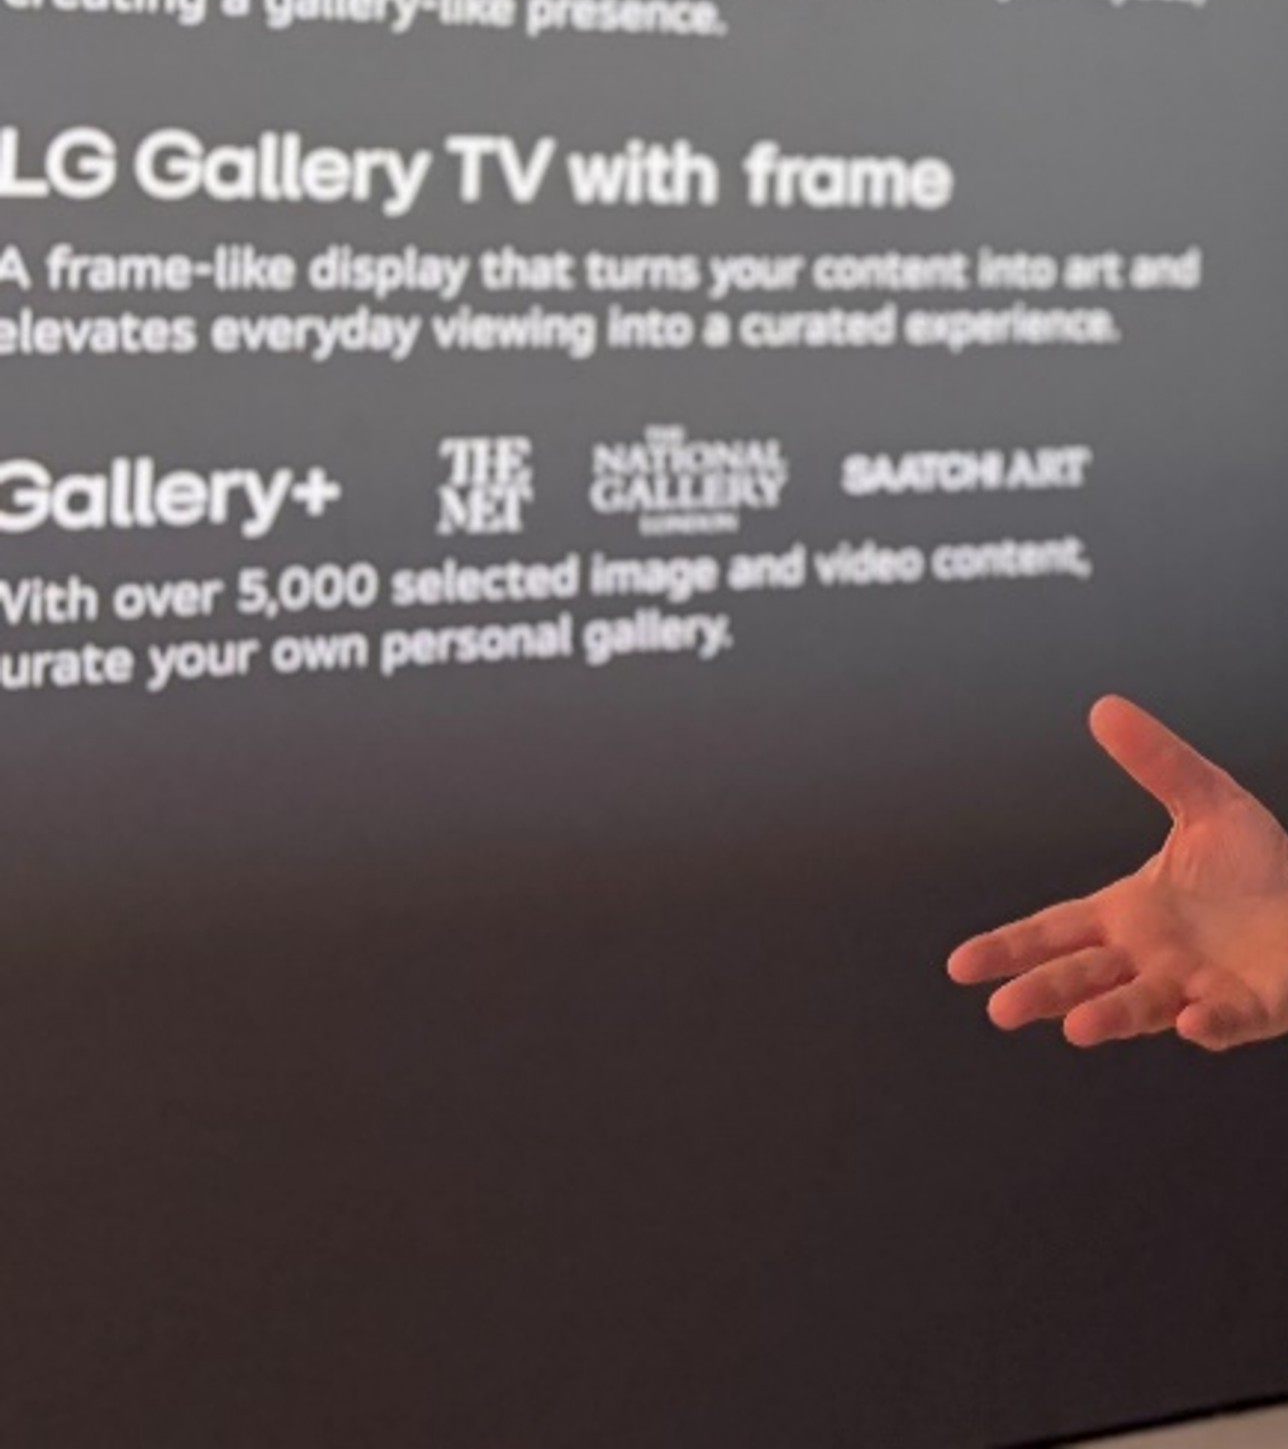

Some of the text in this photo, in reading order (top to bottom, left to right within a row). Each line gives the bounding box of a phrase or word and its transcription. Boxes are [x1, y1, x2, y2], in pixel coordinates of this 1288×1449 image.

[0, 127, 953, 216] LG Gallery TV with frame
[0, 244, 1201, 300] A frame-like display that turns your content into art and
[0, 304, 1118, 361] elevates everyday viewing into a curated experience.
[592, 441, 782, 476] NATIONAL
[843, 446, 1091, 494] SAATCHI ART
[0, 457, 341, 538] Gallery+
[590, 474, 785, 512] GALLERY
[113, 580, 224, 619] over
[238, 563, 378, 618] 5,000
[392, 555, 579, 605] selected
[591, 554, 718, 602] image
[728, 545, 805, 590] and
[814, 541, 924, 584] video
[932, 537, 1091, 580] content,
[147, 639, 260, 692] your
[271, 633, 368, 673] own
[381, 613, 572, 676] personal
[583, 609, 732, 665] gallery.
